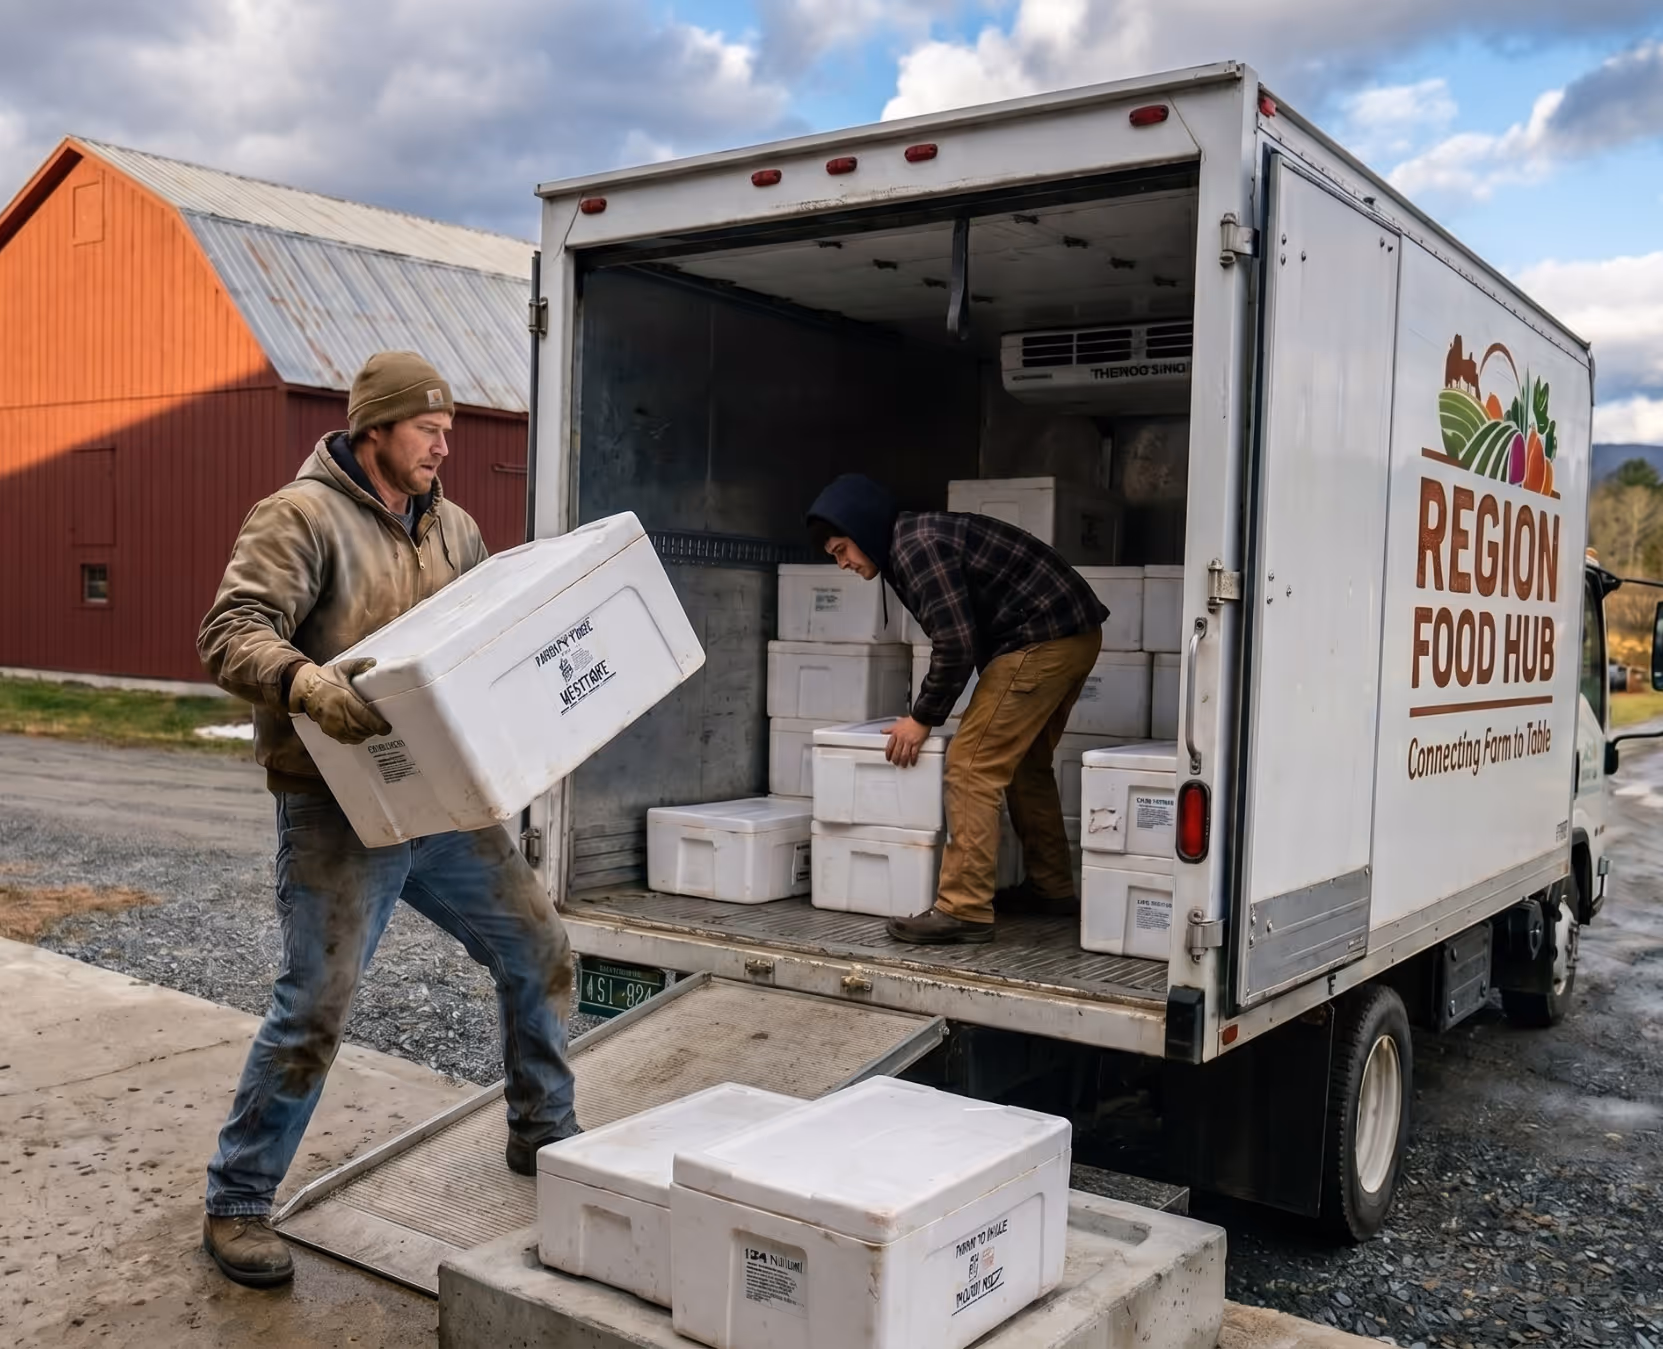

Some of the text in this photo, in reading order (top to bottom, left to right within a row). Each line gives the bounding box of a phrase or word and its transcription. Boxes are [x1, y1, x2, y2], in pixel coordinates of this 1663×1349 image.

[1416, 476, 1560, 602] REGION
[1411, 606, 1555, 689] FOOD HUB
[1408, 719, 1551, 781] Connecting Farm to Table
